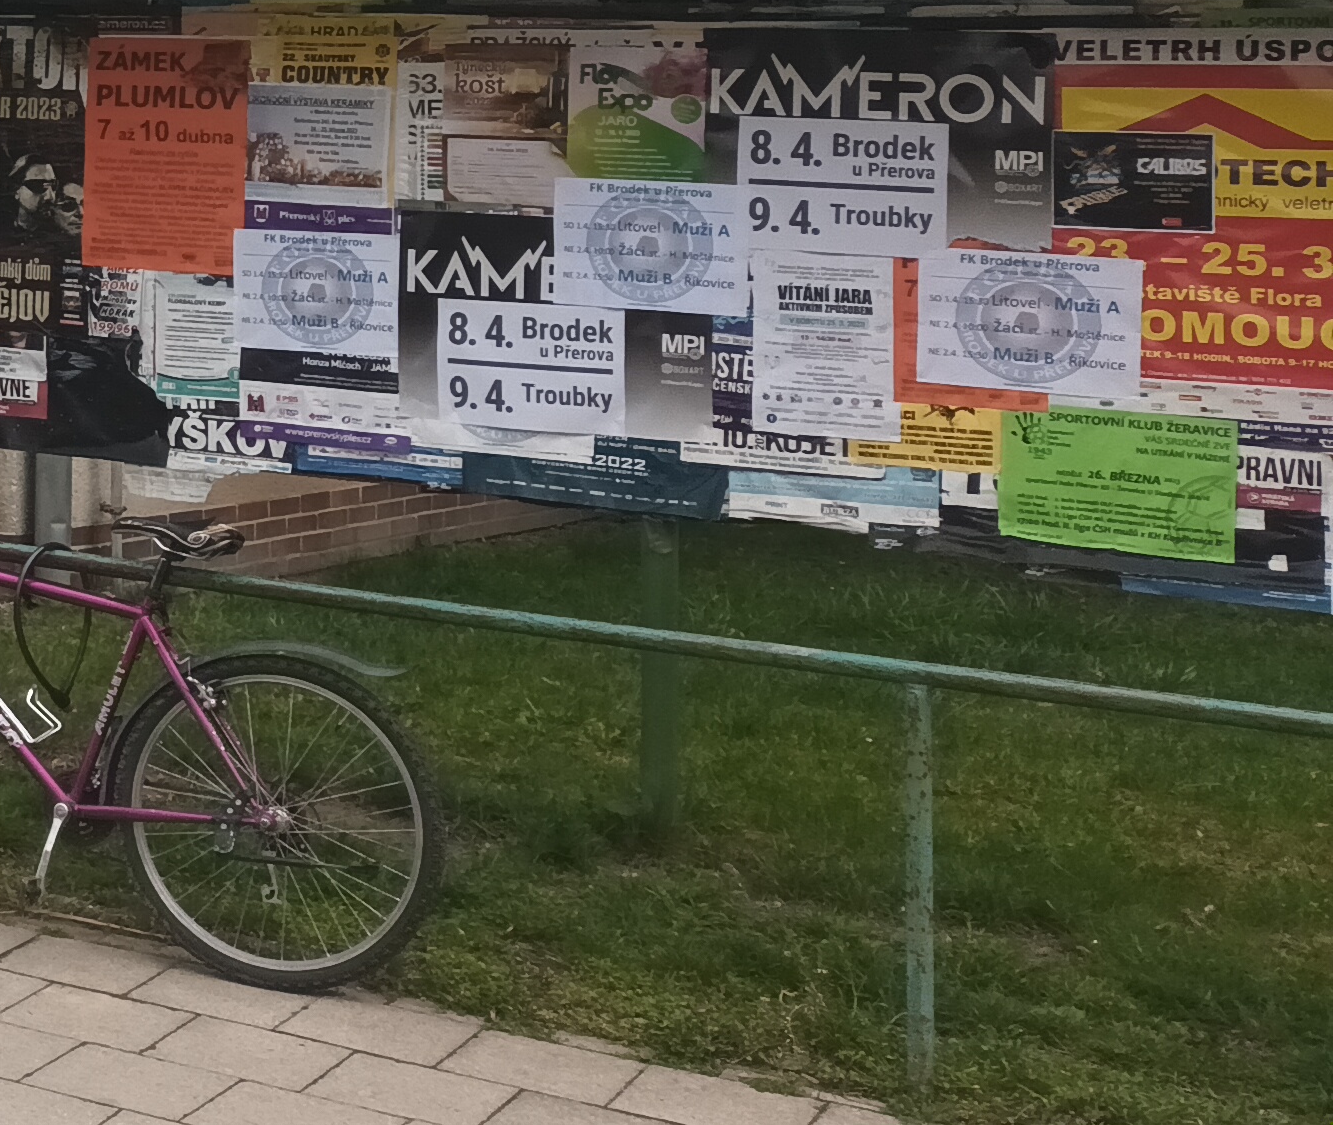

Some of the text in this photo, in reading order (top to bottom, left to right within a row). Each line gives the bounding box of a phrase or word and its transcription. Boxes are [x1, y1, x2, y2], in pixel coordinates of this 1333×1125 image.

[95, 44, 186, 72] ZÁMEK
[1055, 38, 1221, 62] VELETRH
[281, 65, 390, 86] COUNTRY
[453, 73, 506, 95] košt
[95, 84, 241, 110] PLUMLOV
[710, 53, 1046, 125] KAMERON
[16, 96, 61, 120] 2023
[598, 88, 653, 113] Expo
[97, 118, 112, 140] 7
[139, 120, 169, 142] 10
[176, 128, 234, 144] dubna
[597, 116, 637, 127] JARO
[749, 129, 936, 167] 8. 4. Brodek
[852, 162, 936, 180] u Přerova
[994, 150, 1044, 172] MPI
[1214, 159, 1333, 187] TECH
[590, 183, 604, 193] FK
[607, 184, 649, 194] Brodek
[666, 186, 712, 198] Přerova
[748, 196, 933, 235] 9. 4. Troubky
[618, 221, 730, 237] Litovel Muži A
[264, 234, 276, 243] FK
[280, 235, 318, 244] Brodek
[331, 237, 372, 247] Přerova
[618, 242, 645, 256] Žáci
[25, 257, 51, 281] dům
[960, 254, 976, 264] FK
[980, 255, 1028, 268] Brodek
[1046, 259, 1100, 272] Přerova
[1201, 242, 1285, 277] 25.
[1302, 245, 1333, 279] 3
[289, 269, 388, 284] Litovel Muži A
[618, 269, 658, 283] Muži
[663, 273, 672, 284] B
[291, 289, 315, 302] Žáci
[777, 282, 873, 305] VÍTÁNÍ JARA
[992, 295, 1041, 309] Litovel
[1054, 297, 1100, 314] Muži
[1106, 301, 1121, 314] A
[1141, 283, 1322, 307] taviště Flora
[291, 315, 327, 327] Muži
[330, 318, 339, 329] B
[448, 312, 614, 348] 8. 4. Brodek
[993, 319, 1024, 334] Žáci
[540, 344, 614, 361] u Přerova
[660, 333, 705, 355] MPI
[993, 347, 1039, 363] Muži
[1044, 351, 1055, 364] B
[1238, 355, 1285, 366] SOBOTA
[449, 375, 613, 413] 9. 4. Troubky
[1048, 411, 1232, 438] SPORTOVNÍ KLUB ŽERAVICE
[594, 454, 646, 470] 2022
[1109, 470, 1161, 485] BŘEZNA
[95, 666, 126, 736] AMULET
